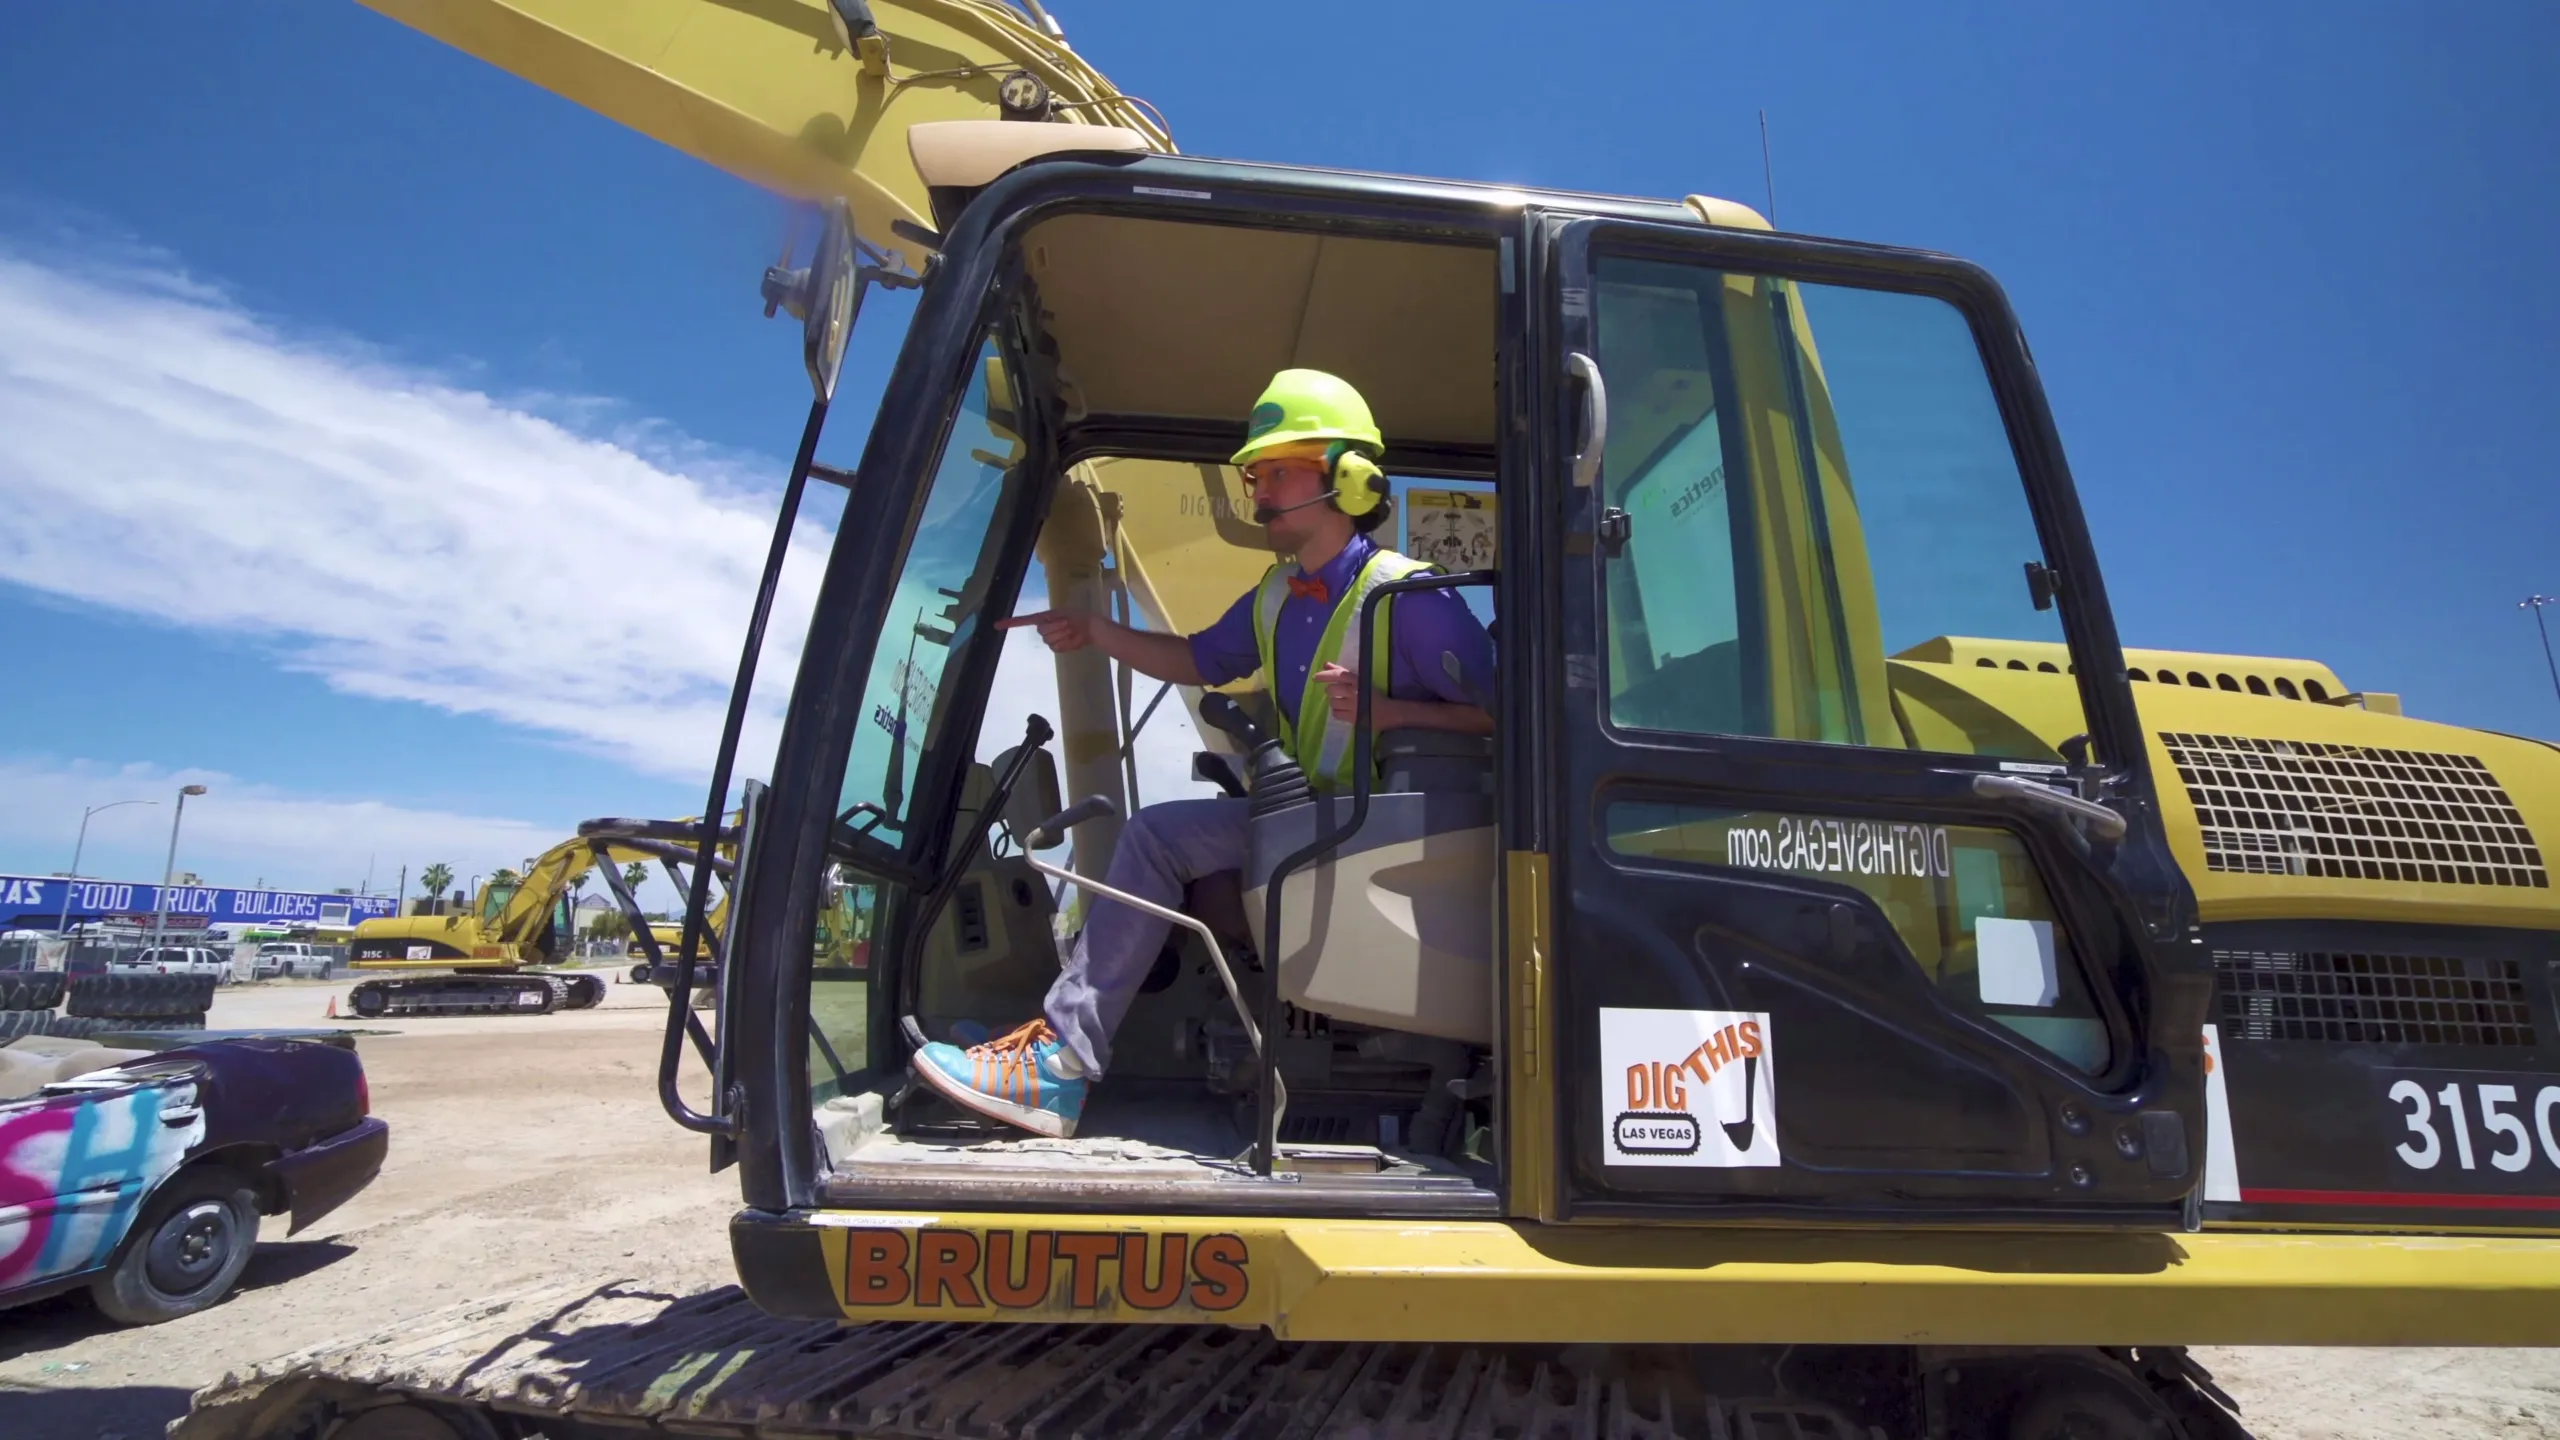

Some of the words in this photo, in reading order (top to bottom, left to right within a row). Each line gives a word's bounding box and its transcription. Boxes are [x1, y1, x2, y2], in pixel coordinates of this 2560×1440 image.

[1180, 494, 1257, 520] DIGTHISV
[68, 883, 133, 910] FOOD
[152, 887, 219, 913] TRUCK
[233, 892, 317, 916] BUILDERS
[361, 951, 382, 959] 315C
[1627, 1061, 1687, 1112] DIG
[1680, 1021, 1763, 1085] THIS
[1622, 1128, 1646, 1139] LAS
[1649, 1128, 1692, 1140] VEGAS
[845, 1228, 1249, 1311] BRUTUS
